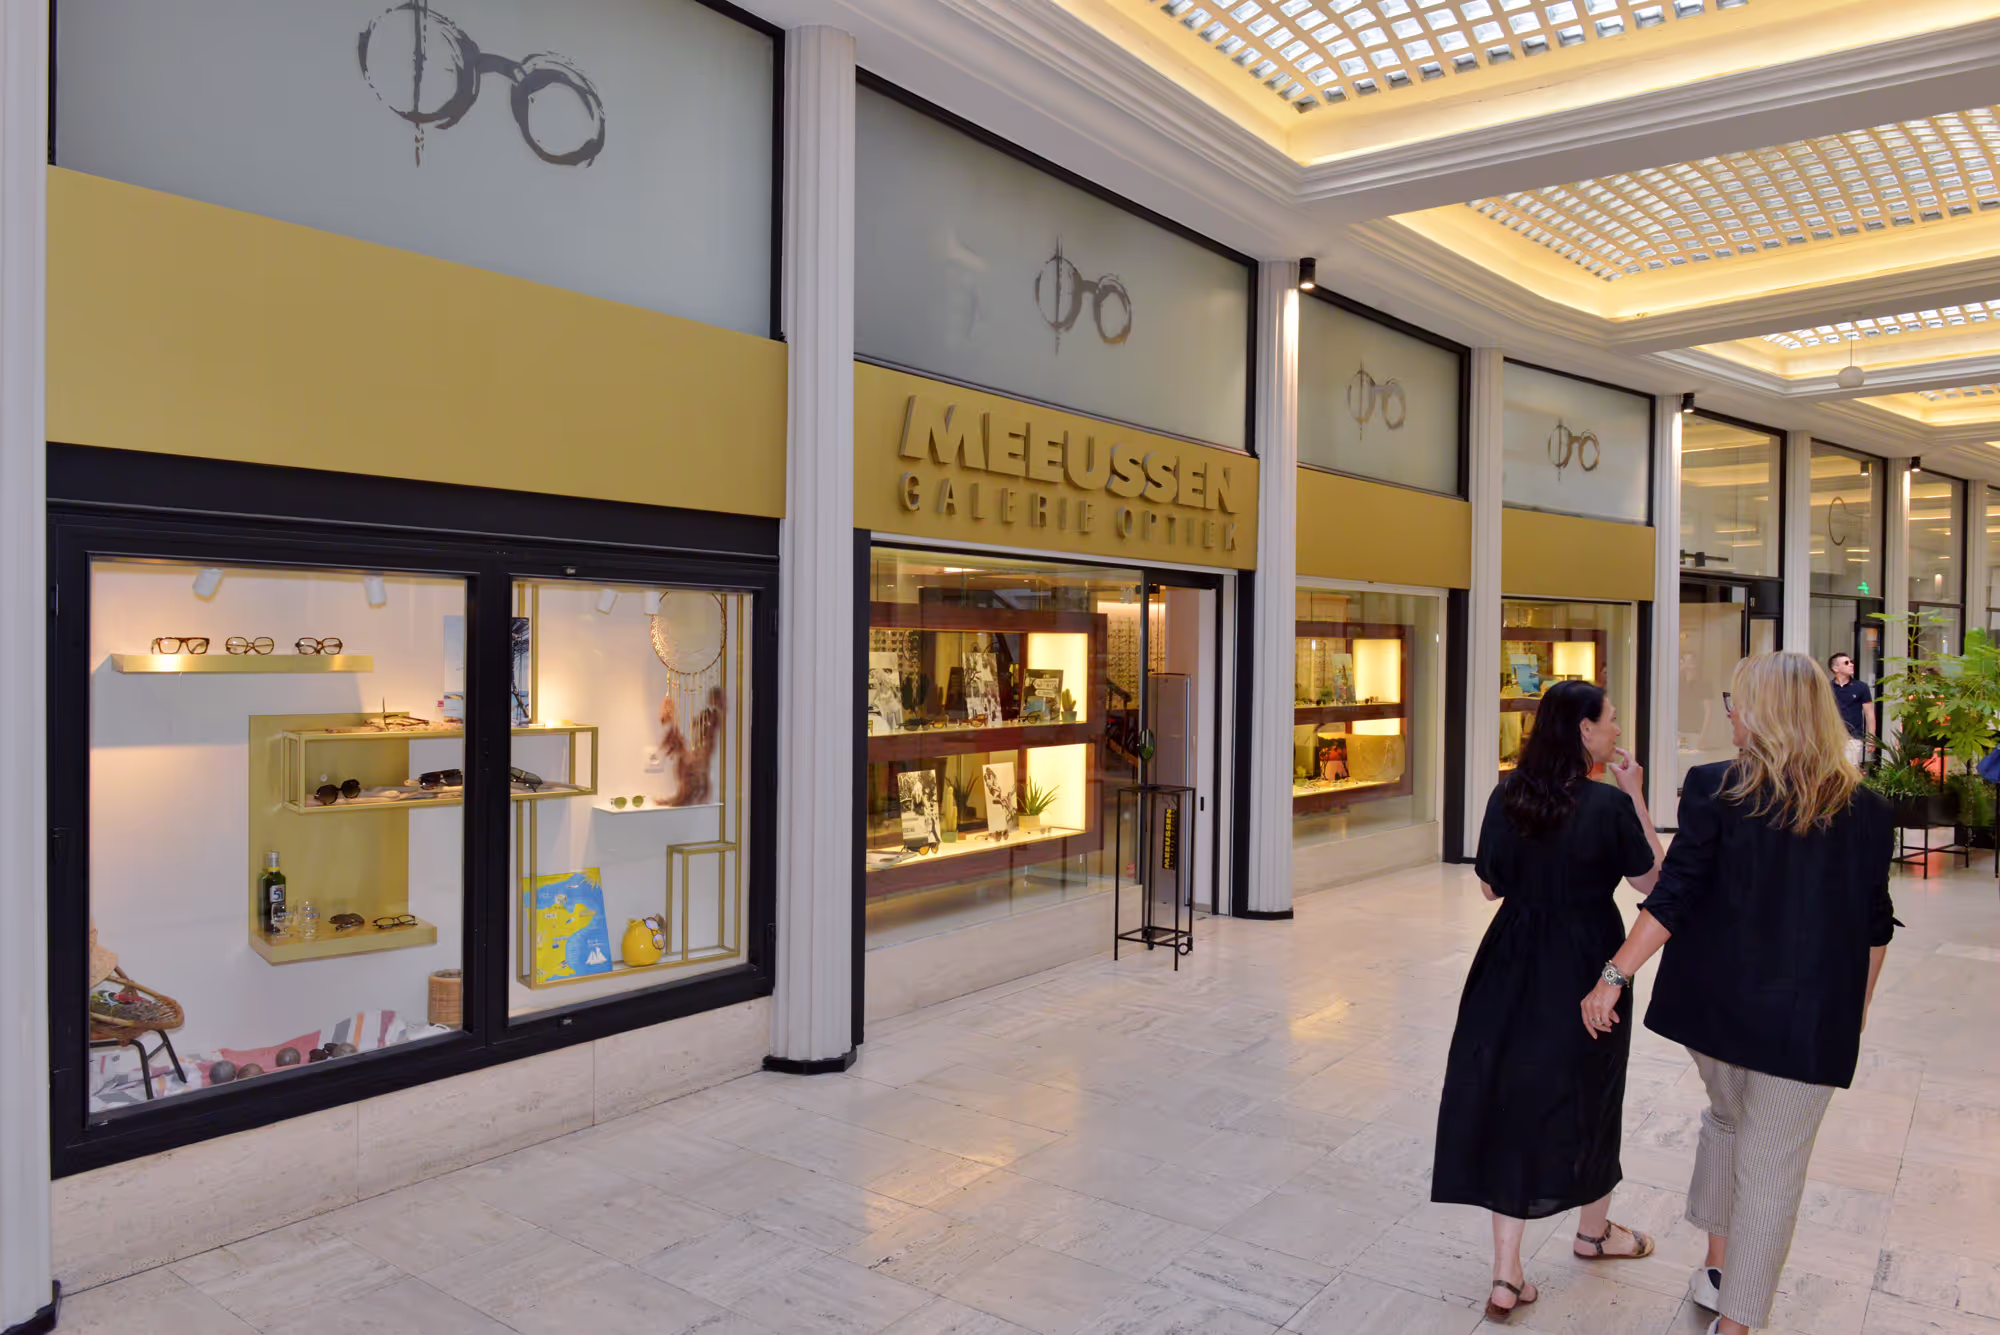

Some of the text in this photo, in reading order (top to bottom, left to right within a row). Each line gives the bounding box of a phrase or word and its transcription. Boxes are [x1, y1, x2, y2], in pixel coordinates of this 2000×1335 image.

[899, 394, 1240, 515] MEEUSSEN
[900, 471, 1238, 551] GALERIE OPTIEK
[1164, 808, 1172, 869] MEEUSSEN
[273, 890, 284, 901] 51
